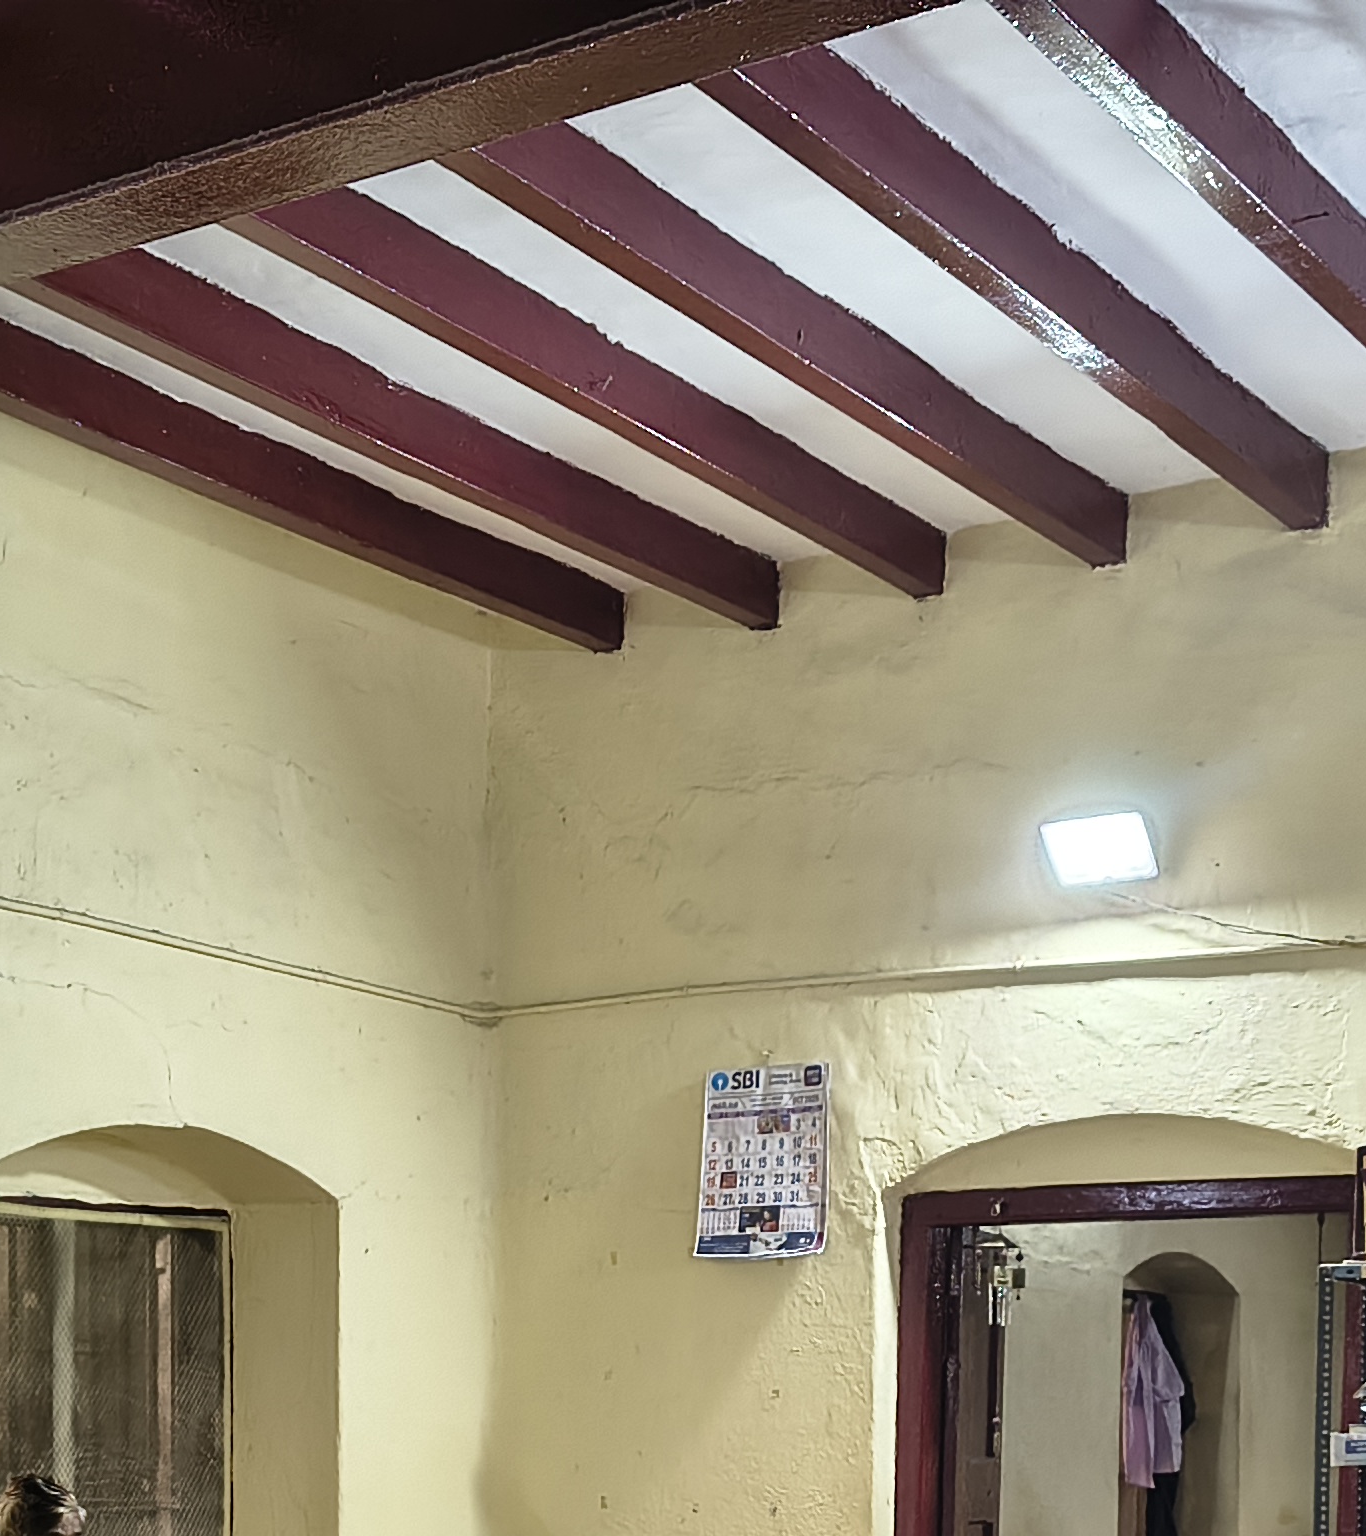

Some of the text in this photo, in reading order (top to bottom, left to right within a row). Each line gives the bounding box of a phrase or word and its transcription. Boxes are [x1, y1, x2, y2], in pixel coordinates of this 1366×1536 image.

[730, 1070, 760, 1090] SBI
[711, 1141, 717, 1152] 5
[727, 1141, 733, 1153] 6
[745, 1140, 751, 1151] 7
[779, 1137, 785, 1149] 9
[793, 1136, 802, 1149] 10
[809, 1134, 817, 1147] 11
[708, 1152, 817, 1171] 12 13 14 15 16 17 18
[739, 1175, 749, 1187] 21
[754, 1174, 765, 1186] 22
[774, 1173, 784, 1185] 23
[791, 1172, 800, 1184] 24
[706, 1189, 800, 1206] 26 27 28 29 30 31
